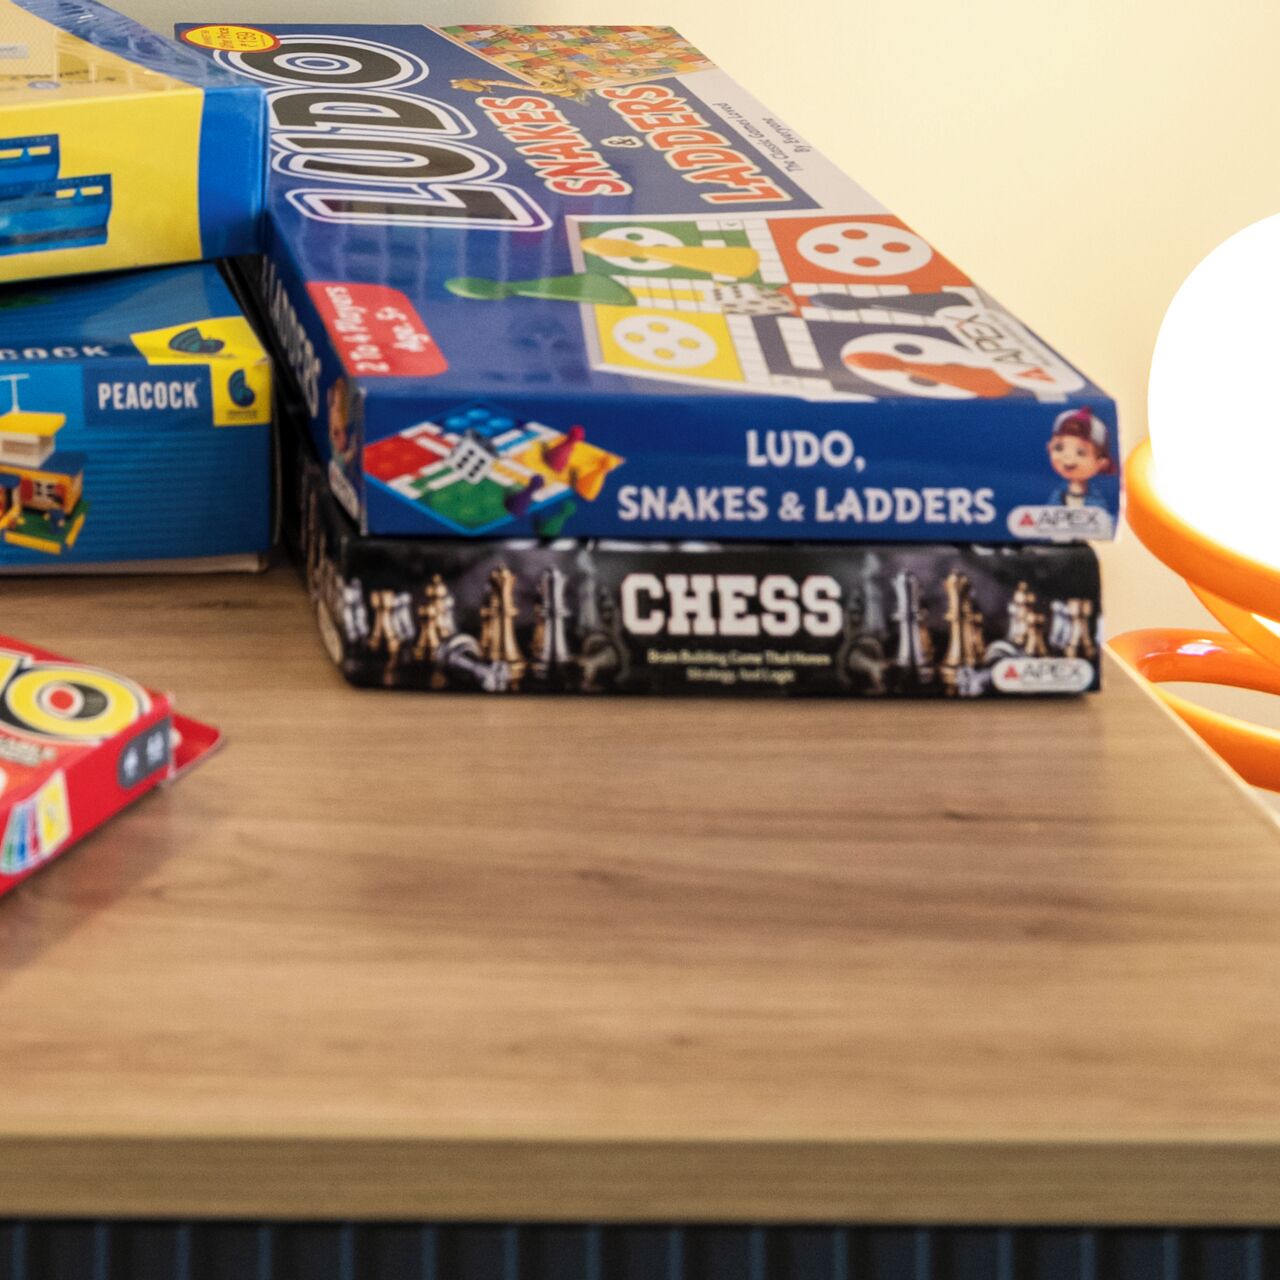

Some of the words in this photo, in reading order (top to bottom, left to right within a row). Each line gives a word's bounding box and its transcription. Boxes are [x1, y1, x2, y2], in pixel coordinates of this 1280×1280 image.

[220, 35, 547, 231] LUDO
[475, 94, 634, 197] SNAKES
[597, 84, 795, 204] LADDERS
[97, 382, 199, 411] PEACOCK
[746, 430, 867, 473] LUDO,
[617, 485, 768, 521] SNAKES
[778, 491, 805, 522] &
[815, 487, 996, 524] LADDERS
[1036, 508, 1101, 529] APEX
[620, 572, 844, 637] CHESS
[1022, 663, 1086, 681] APEX
